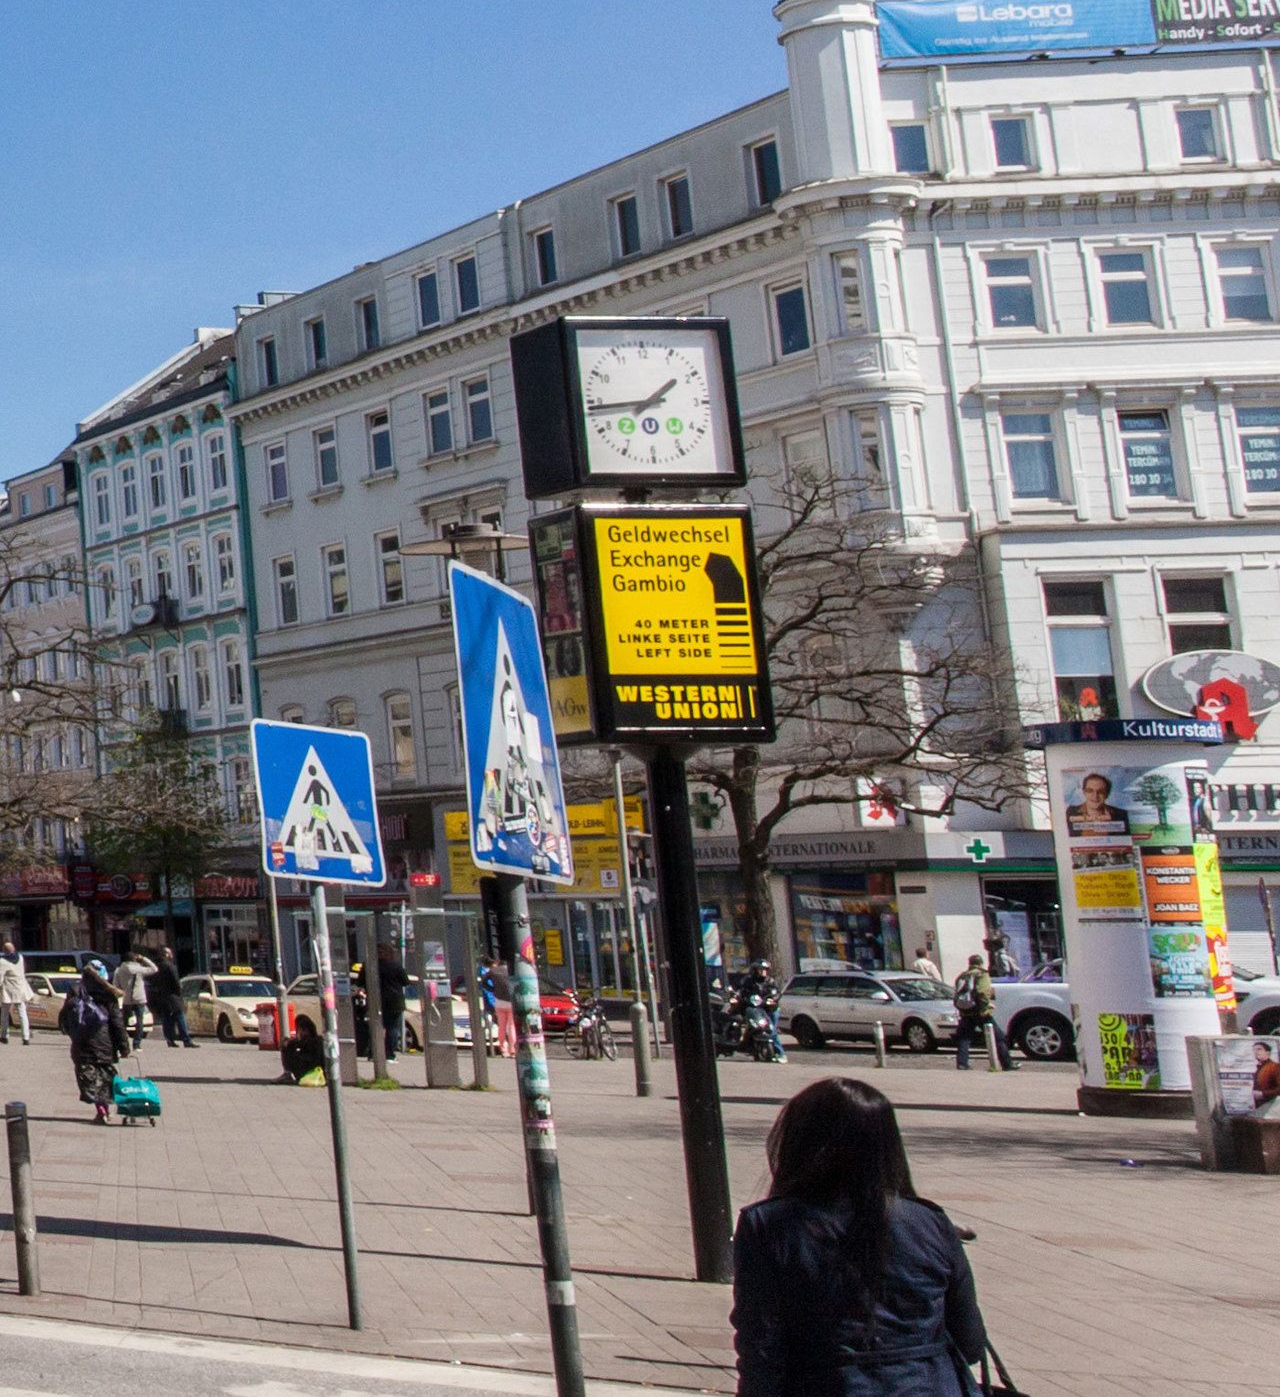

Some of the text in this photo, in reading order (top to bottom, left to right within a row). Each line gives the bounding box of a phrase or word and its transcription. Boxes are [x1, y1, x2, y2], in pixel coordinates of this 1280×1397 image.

[979, 3, 1073, 22] Lebara
[1158, 26, 1205, 40] Handy
[1216, 22, 1263, 37] Sofort
[607, 525, 730, 543] Geldwechsel
[610, 549, 701, 572] Exchange
[612, 574, 687, 592] Gambio
[635, 619, 710, 629] 40 METER
[618, 634, 711, 644] LINKE SEITE
[636, 648, 713, 658] LEFT SIDE
[615, 685, 737, 702] WESTERN
[654, 703, 737, 720] UNION
[1123, 720, 1218, 738] Kulturstadt
[767, 841, 877, 858] NTERNATIONALE
[1155, 903, 1178, 912] JOAN
